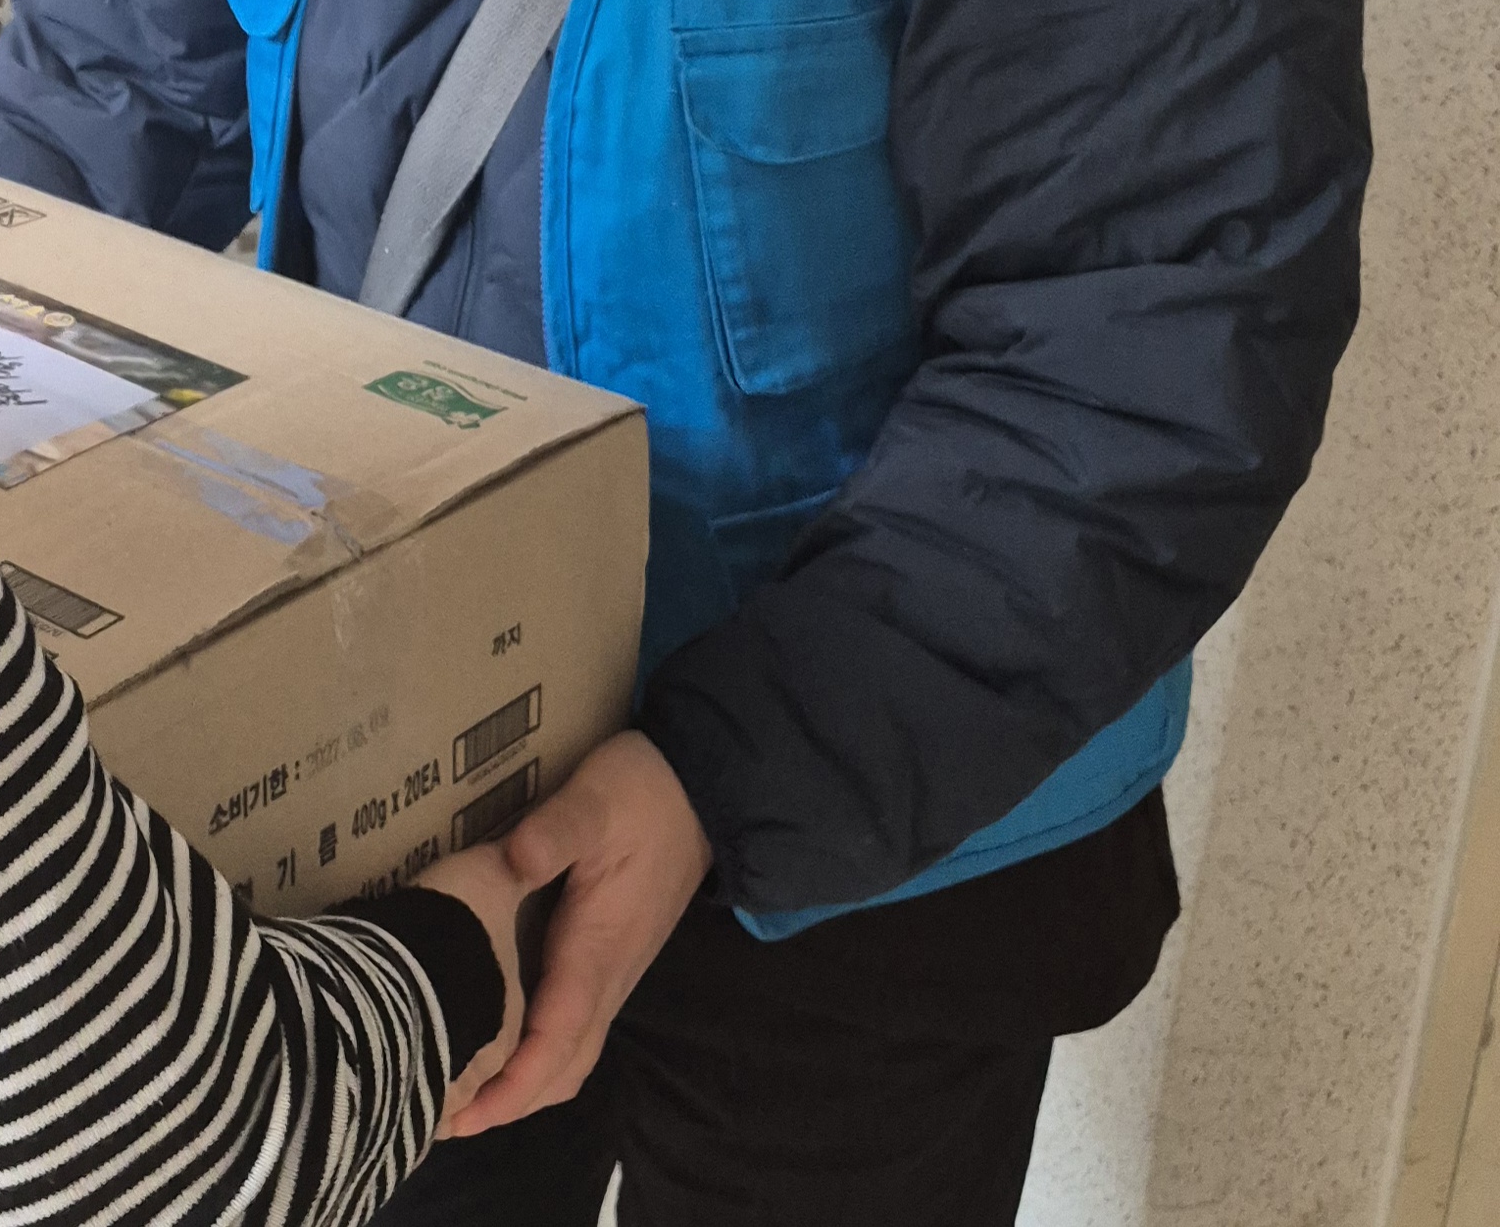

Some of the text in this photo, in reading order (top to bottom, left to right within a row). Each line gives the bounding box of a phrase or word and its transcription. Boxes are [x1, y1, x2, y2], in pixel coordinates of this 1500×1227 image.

[207, 762, 290, 836] 소비기한
[491, 622, 522, 656] 까지
[351, 796, 388, 840] 400g
[403, 757, 442, 809] 20EA
